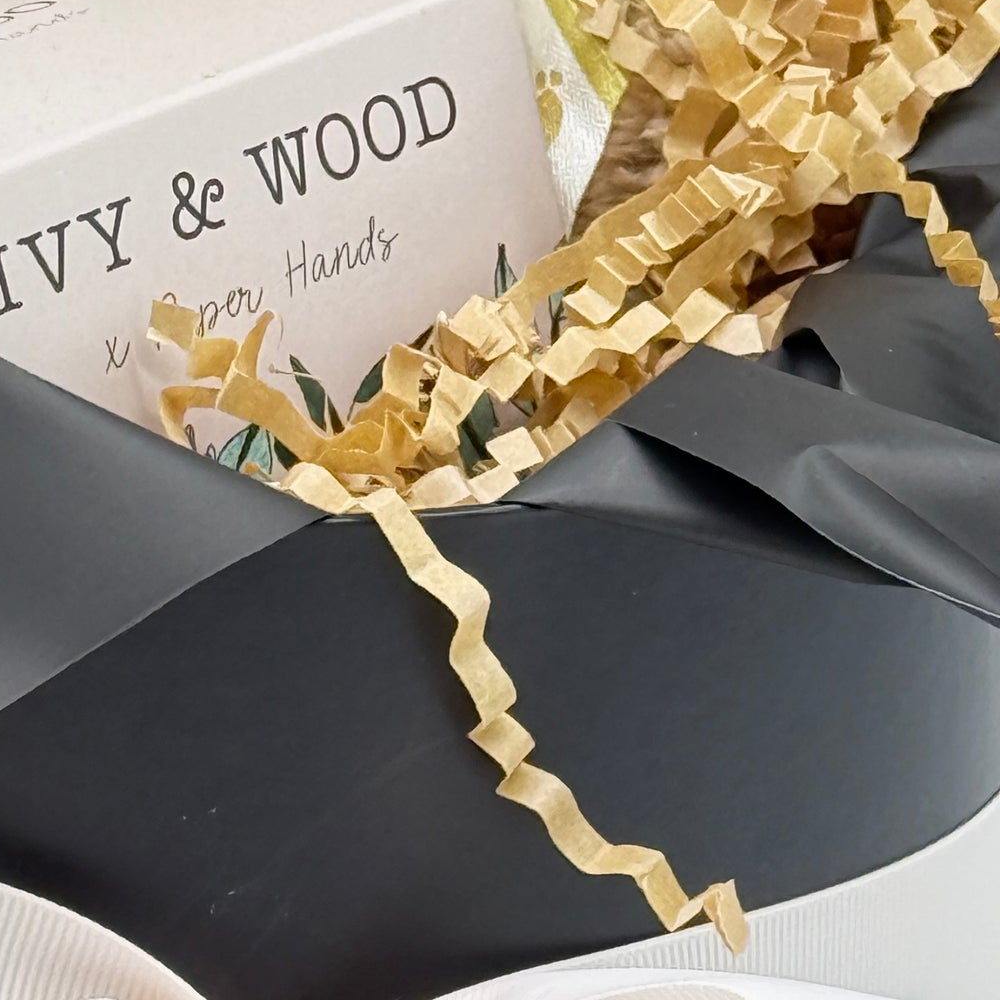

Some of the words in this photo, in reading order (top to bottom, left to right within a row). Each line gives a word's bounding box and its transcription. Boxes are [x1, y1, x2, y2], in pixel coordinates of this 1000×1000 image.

[171, 171, 226, 241] &
[243, 76, 457, 206] WOOD
[104, 336, 131, 375] x
[284, 215, 399, 298] Hands
